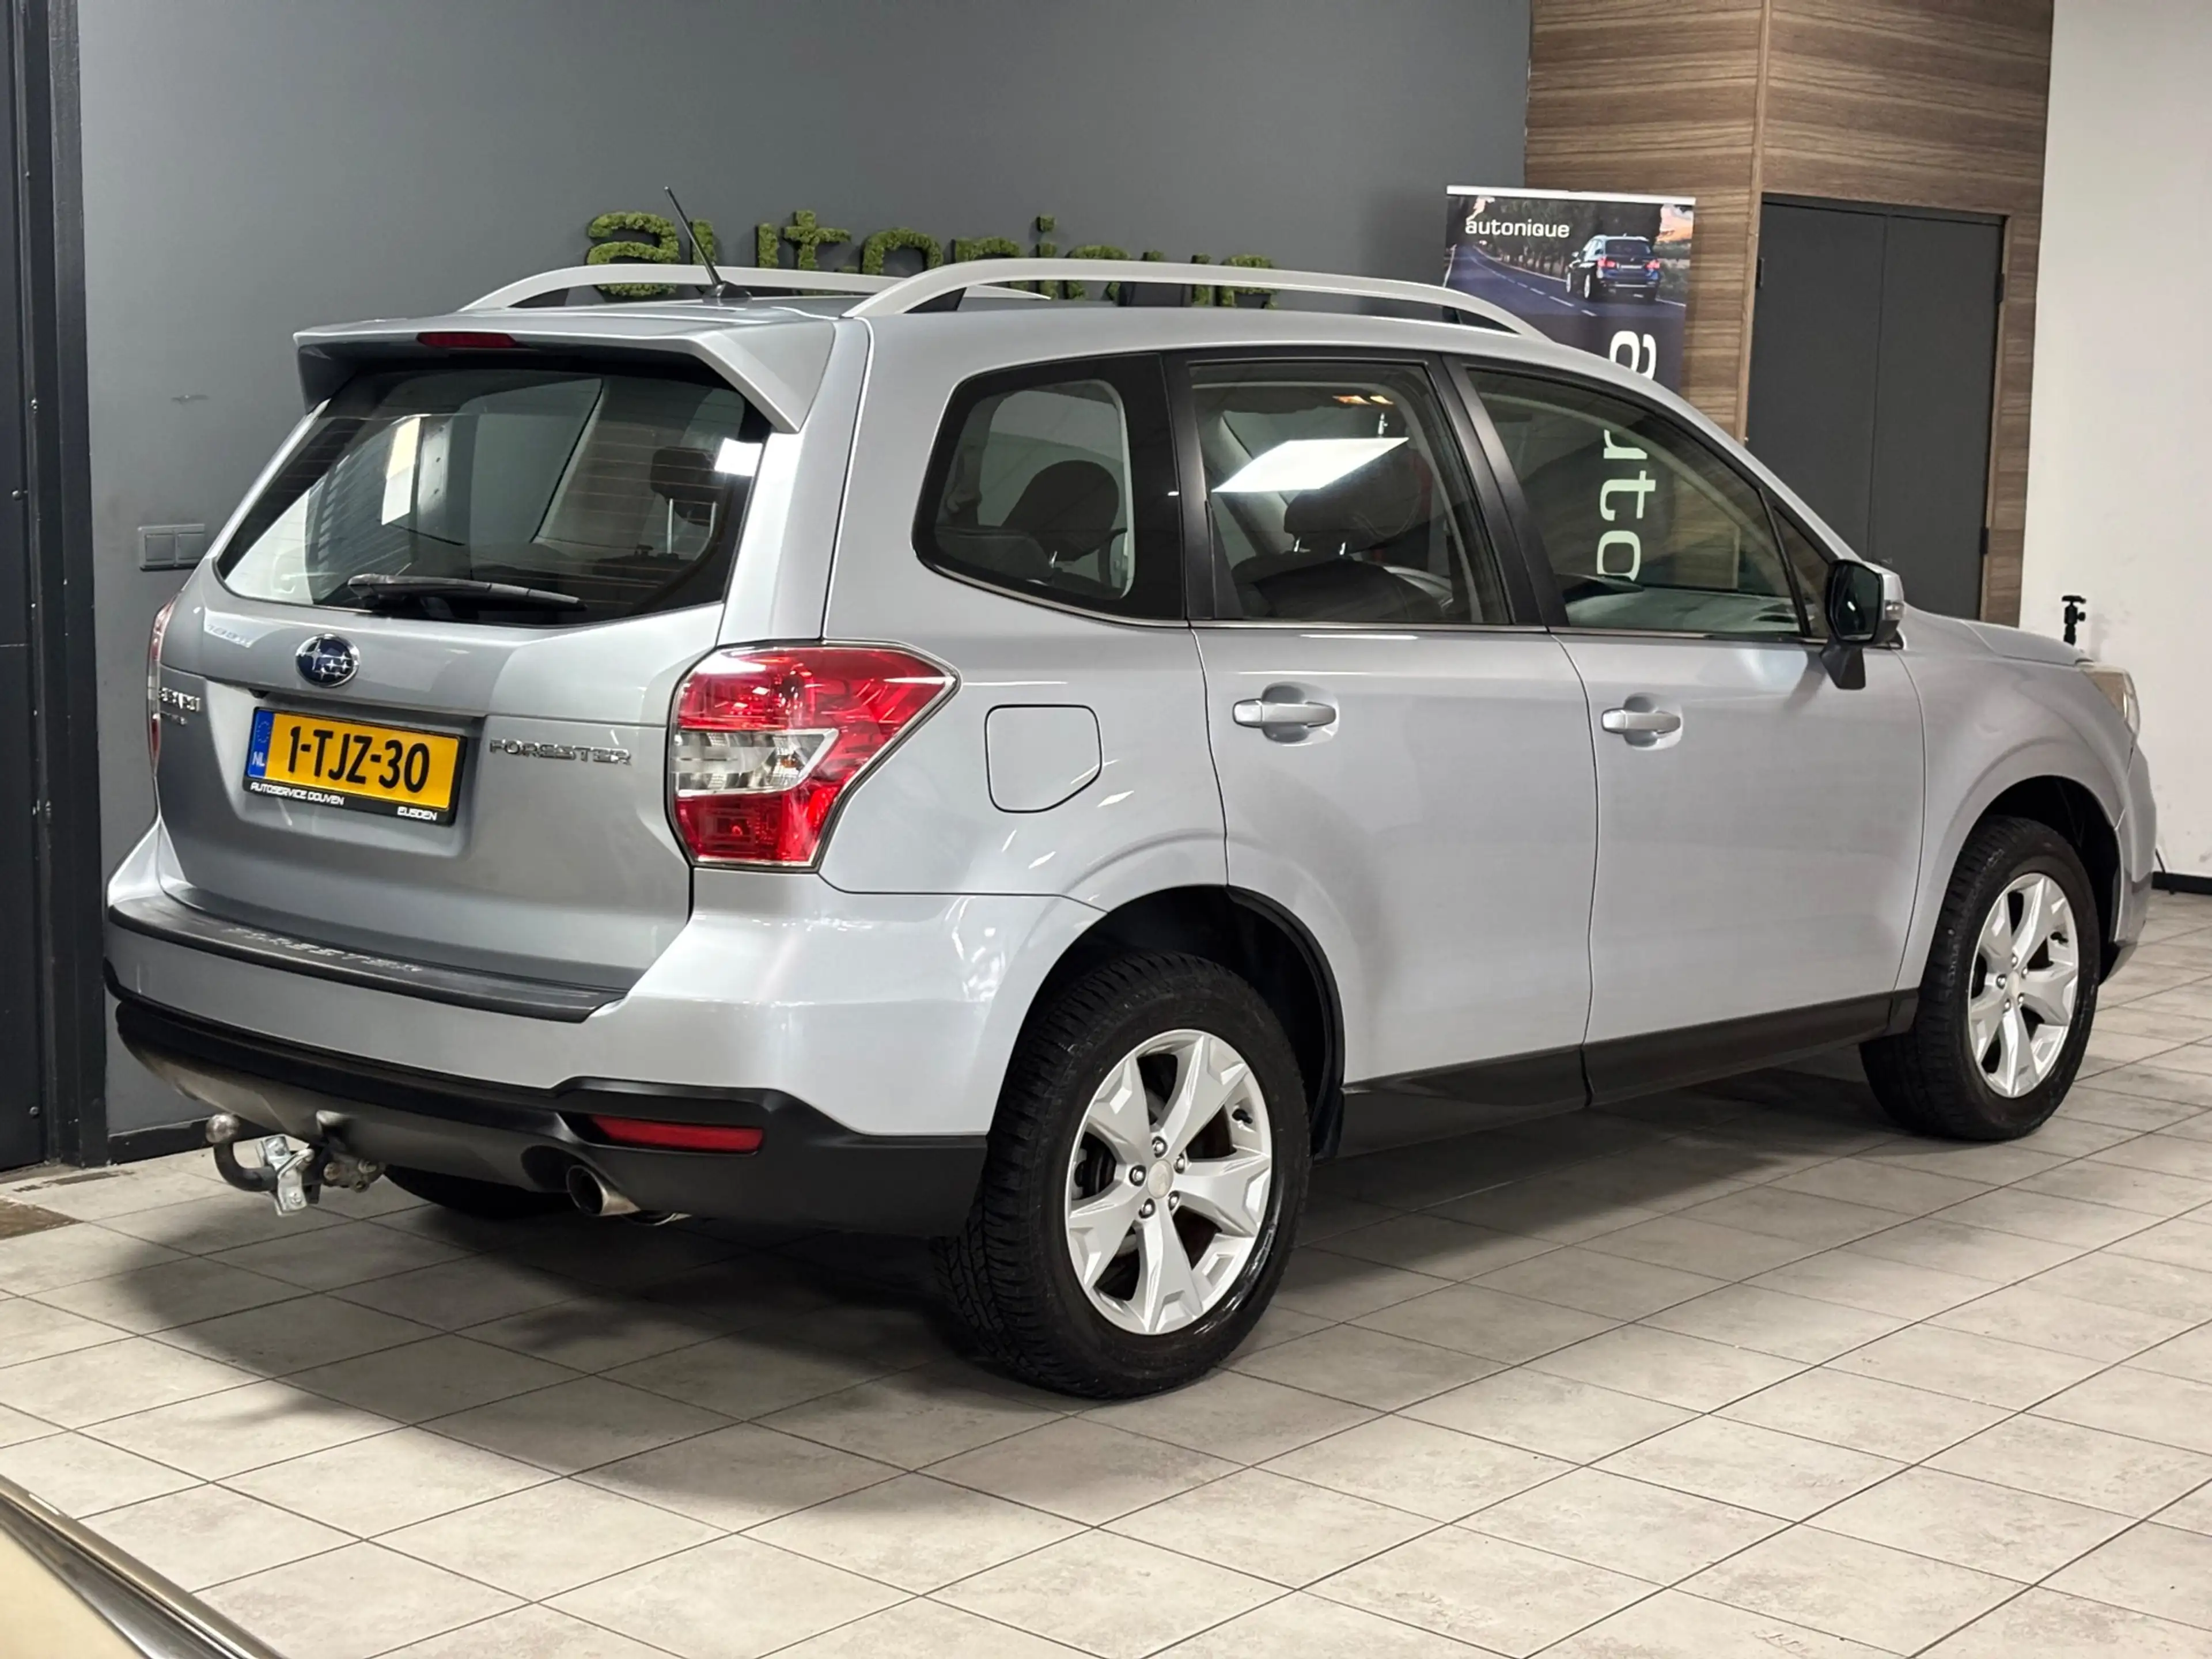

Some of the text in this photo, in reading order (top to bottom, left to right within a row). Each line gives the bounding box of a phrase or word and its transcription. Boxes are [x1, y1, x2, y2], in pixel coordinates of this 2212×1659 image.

[1465, 219, 1570, 238] autonique
[252, 751, 266, 767] NL
[287, 725, 430, 793] 1-TJZ-30
[490, 738, 631, 766] FORESTER
[250, 782, 345, 806] AUTOSERVICE DOUVEN
